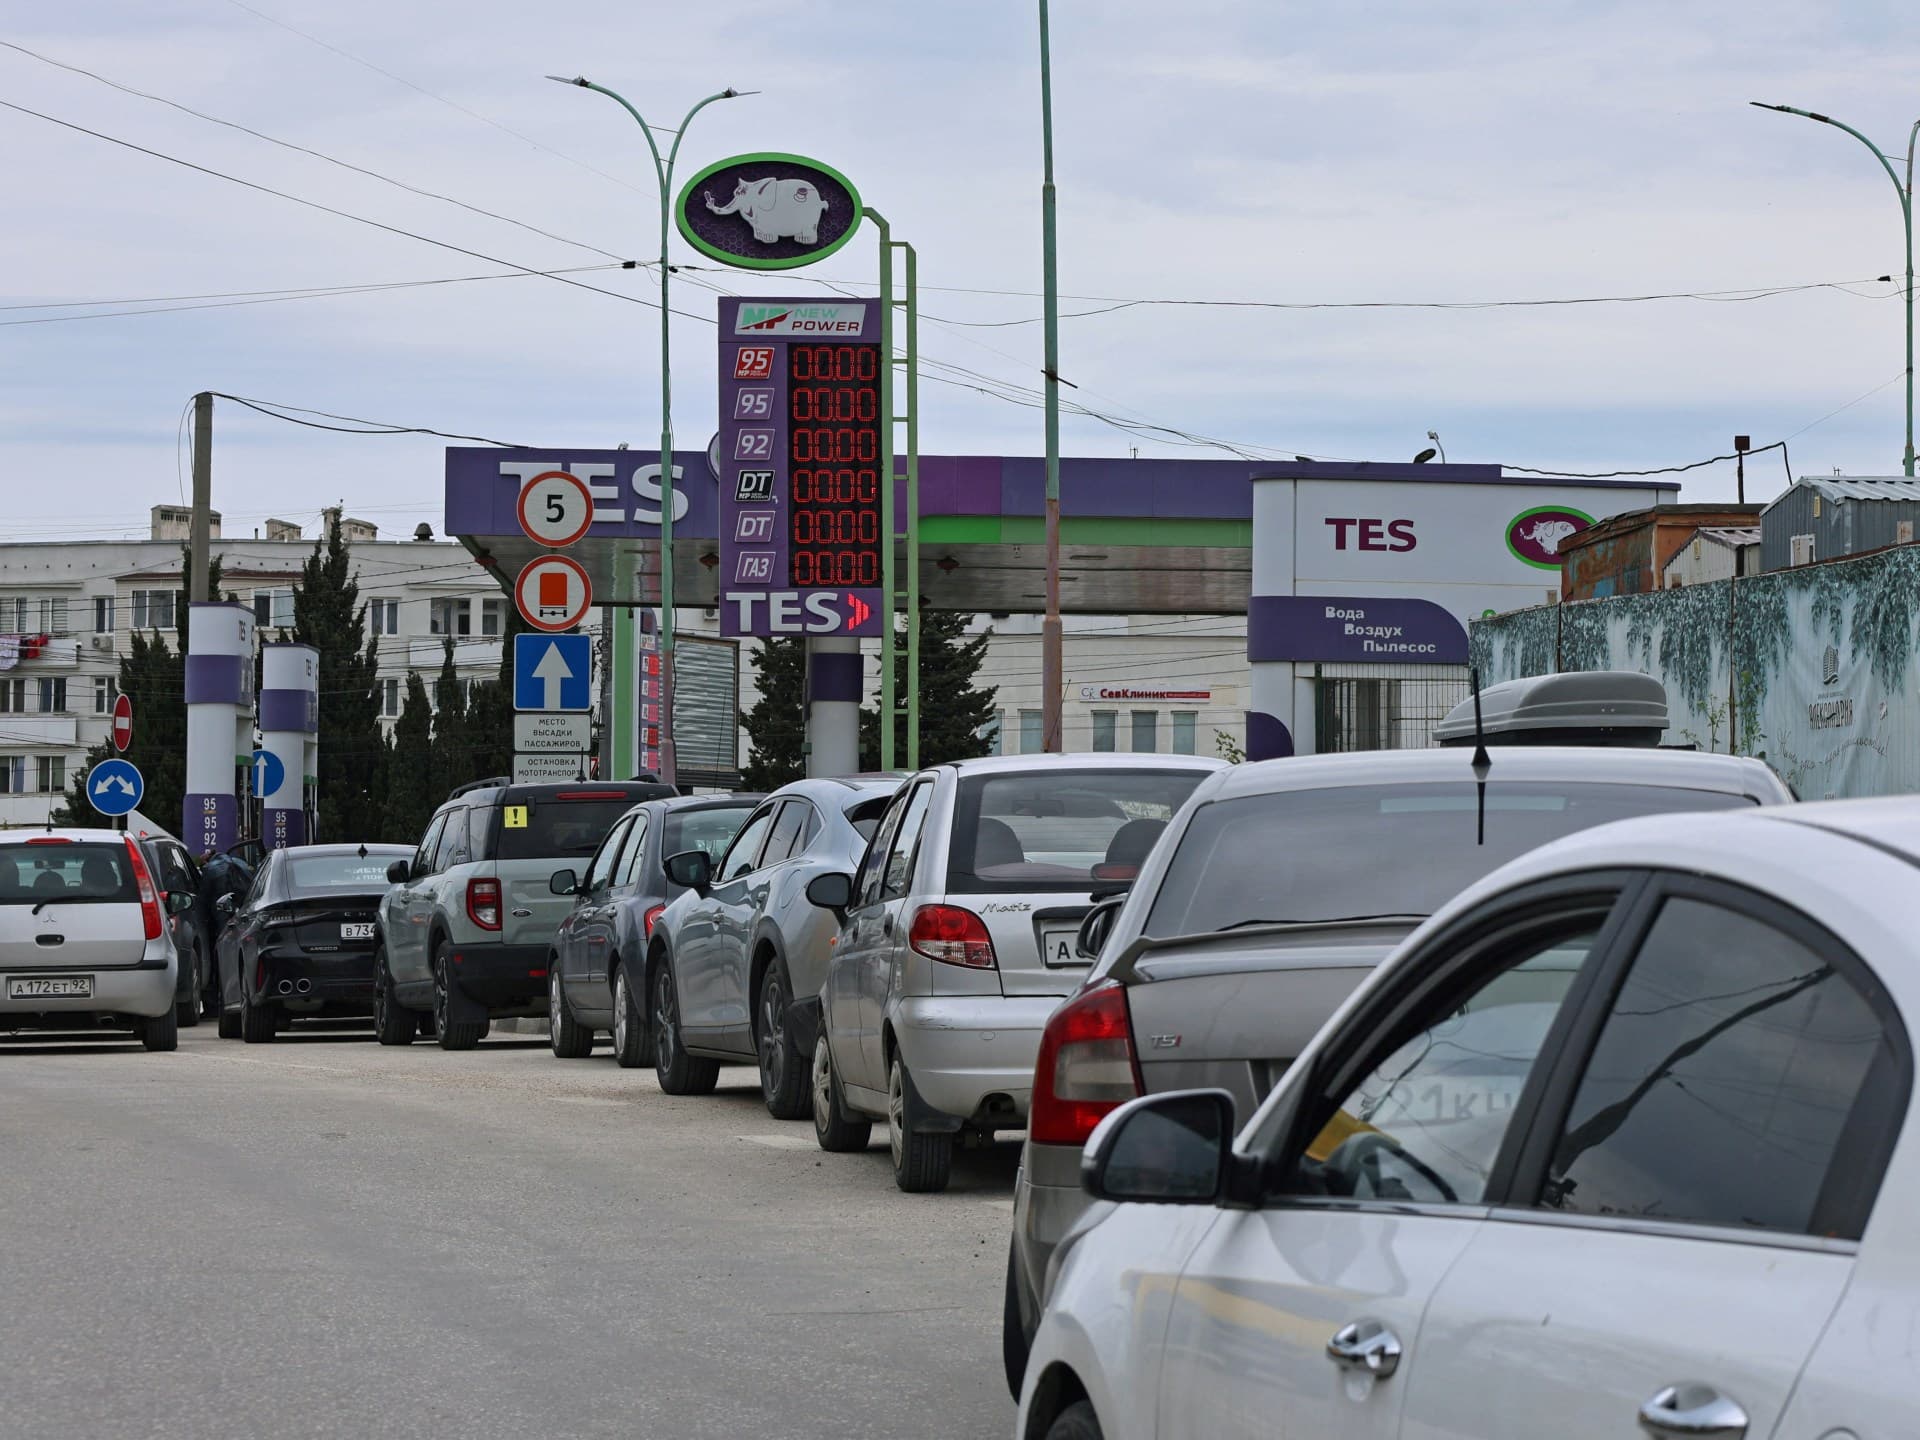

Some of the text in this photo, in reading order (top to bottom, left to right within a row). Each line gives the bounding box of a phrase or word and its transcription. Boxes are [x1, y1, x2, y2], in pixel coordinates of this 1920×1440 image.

[794, 308, 839, 318] NEW
[792, 321, 859, 331] POWER
[741, 350, 769, 370] 95
[741, 394, 769, 414] 95
[741, 434, 769, 455] 92
[740, 473, 771, 492] DT
[499, 461, 689, 525] TES
[546, 494, 565, 523] 5
[740, 517, 771, 537] DT
[1325, 518, 1417, 552] TES
[742, 558, 769, 577] ГАЗ
[725, 591, 842, 633] TES
[1325, 606, 1365, 621] Вода
[1344, 623, 1403, 639] Воздух
[1363, 640, 1436, 653] Пылесос
[1100, 688, 1166, 699] СевКлиник
[524, 740, 581, 748] ПАССАЖИРОВ
[518, 769, 585, 777] МОТОТРАНСПОРТ
[203, 798, 216, 810] 95
[204, 816, 217, 829] 95
[275, 812, 287, 823] 95
[204, 833, 217, 845] 92
[275, 827, 286, 838] 95
[978, 903, 1031, 914] Matiz
